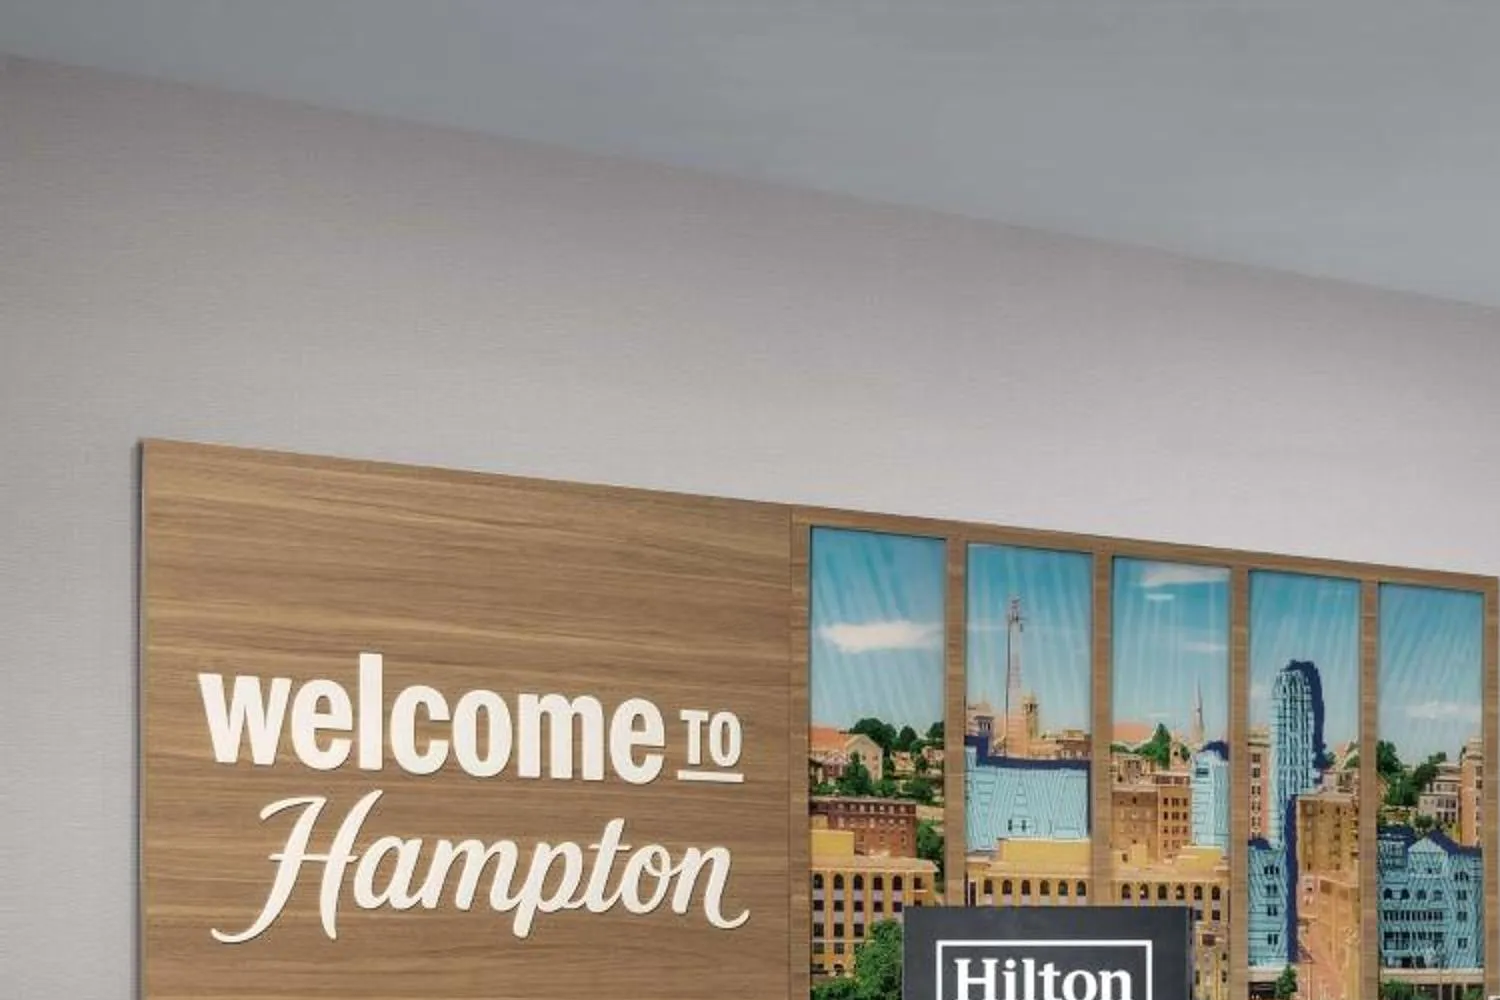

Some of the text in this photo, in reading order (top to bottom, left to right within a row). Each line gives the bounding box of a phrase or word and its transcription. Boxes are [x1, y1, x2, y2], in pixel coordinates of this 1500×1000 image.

[198, 652, 743, 785] welcome TO
[210, 789, 750, 943] Hampton
